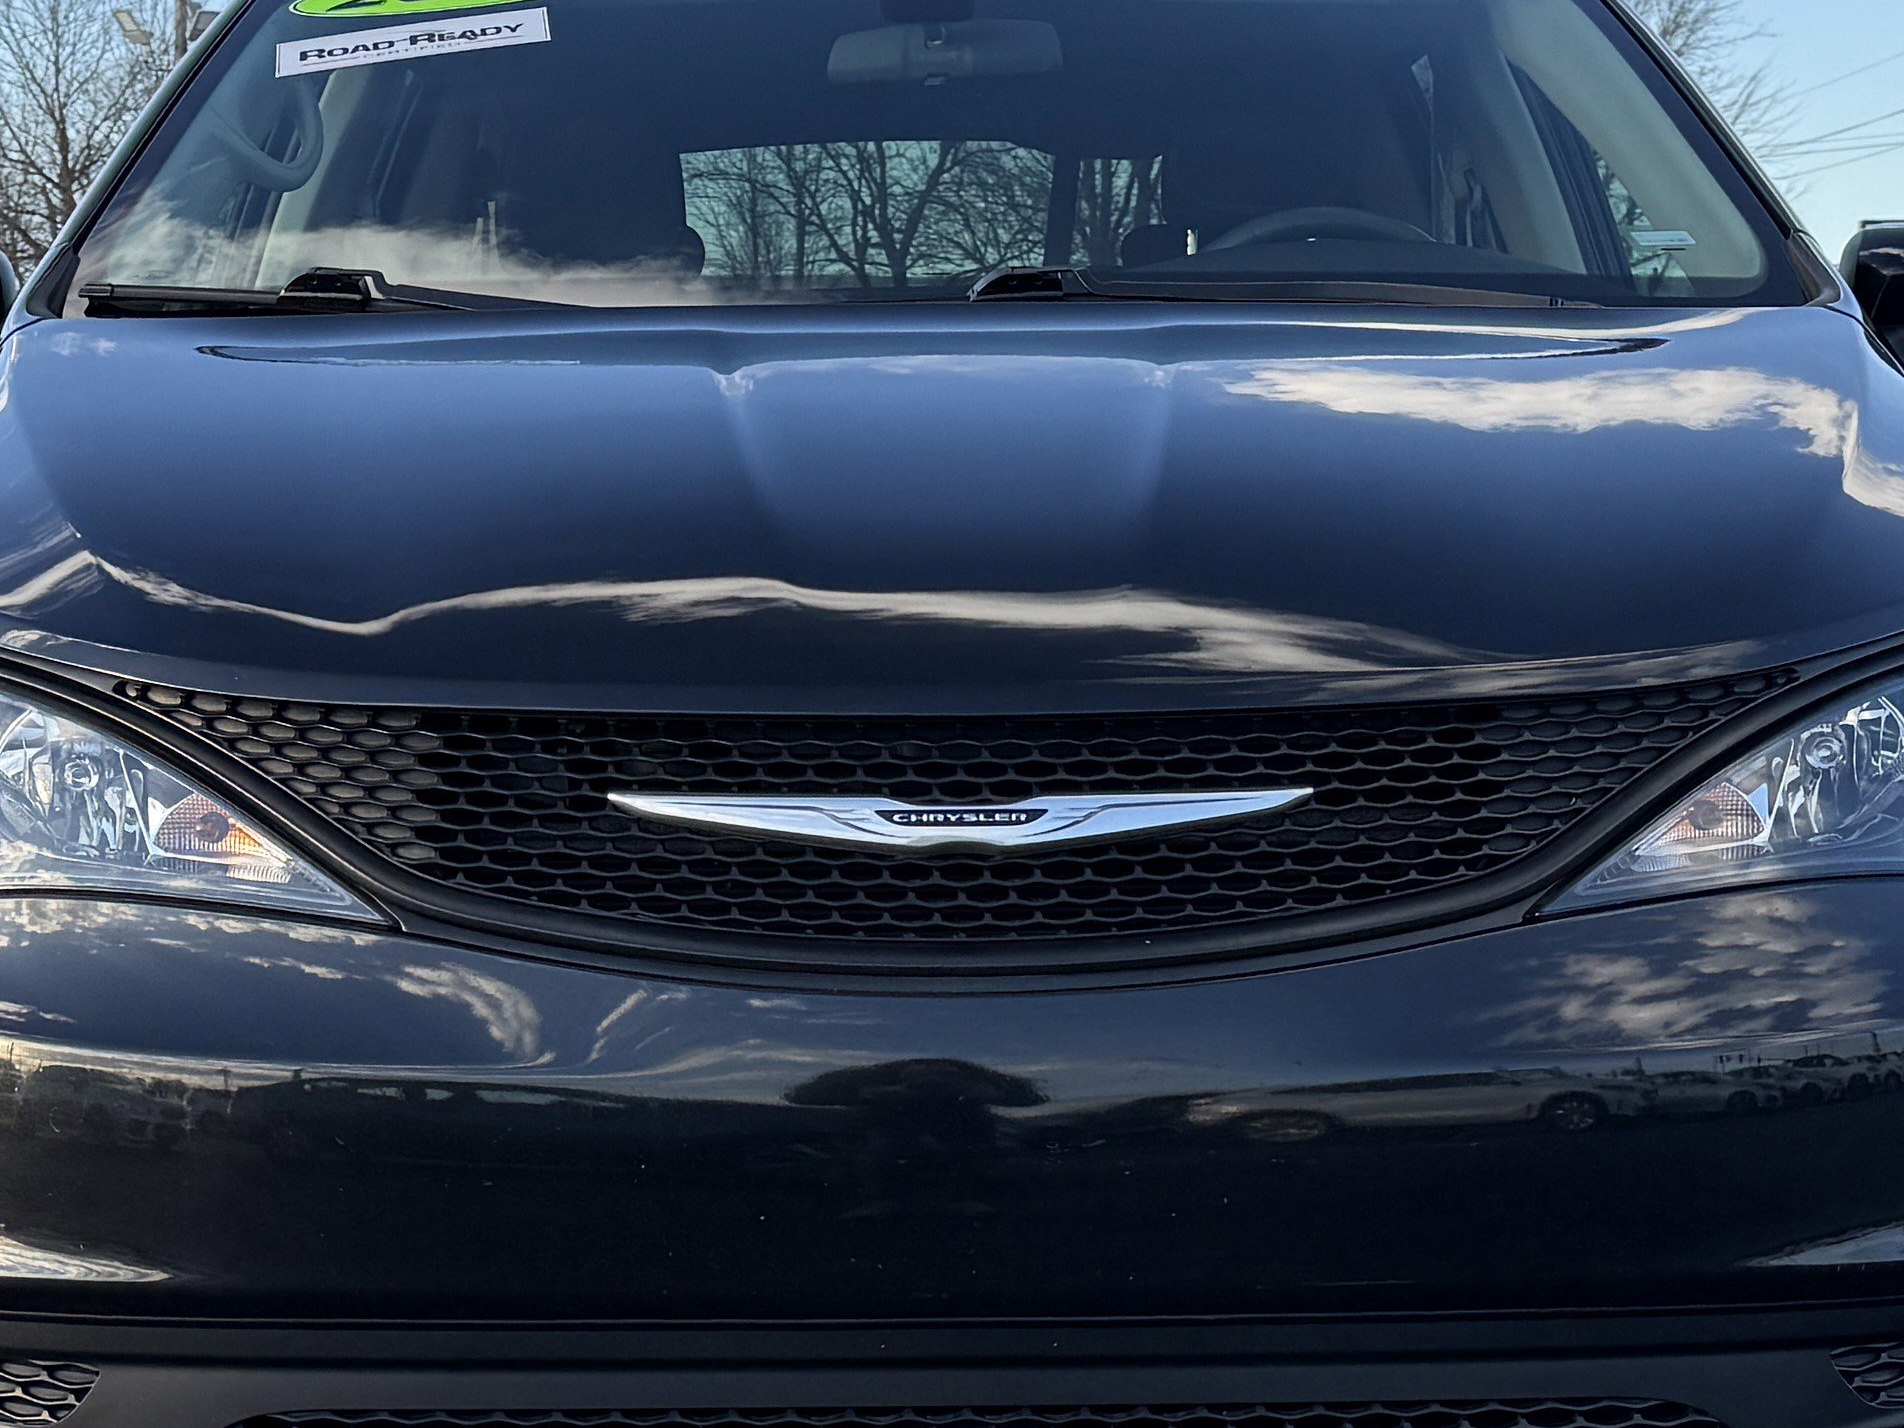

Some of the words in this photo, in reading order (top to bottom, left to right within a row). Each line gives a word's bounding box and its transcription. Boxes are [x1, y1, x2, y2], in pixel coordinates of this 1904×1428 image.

[299, 40, 396, 62] ROAD
[409, 23, 524, 46] READY
[892, 812, 1028, 823] CHRYSLER
